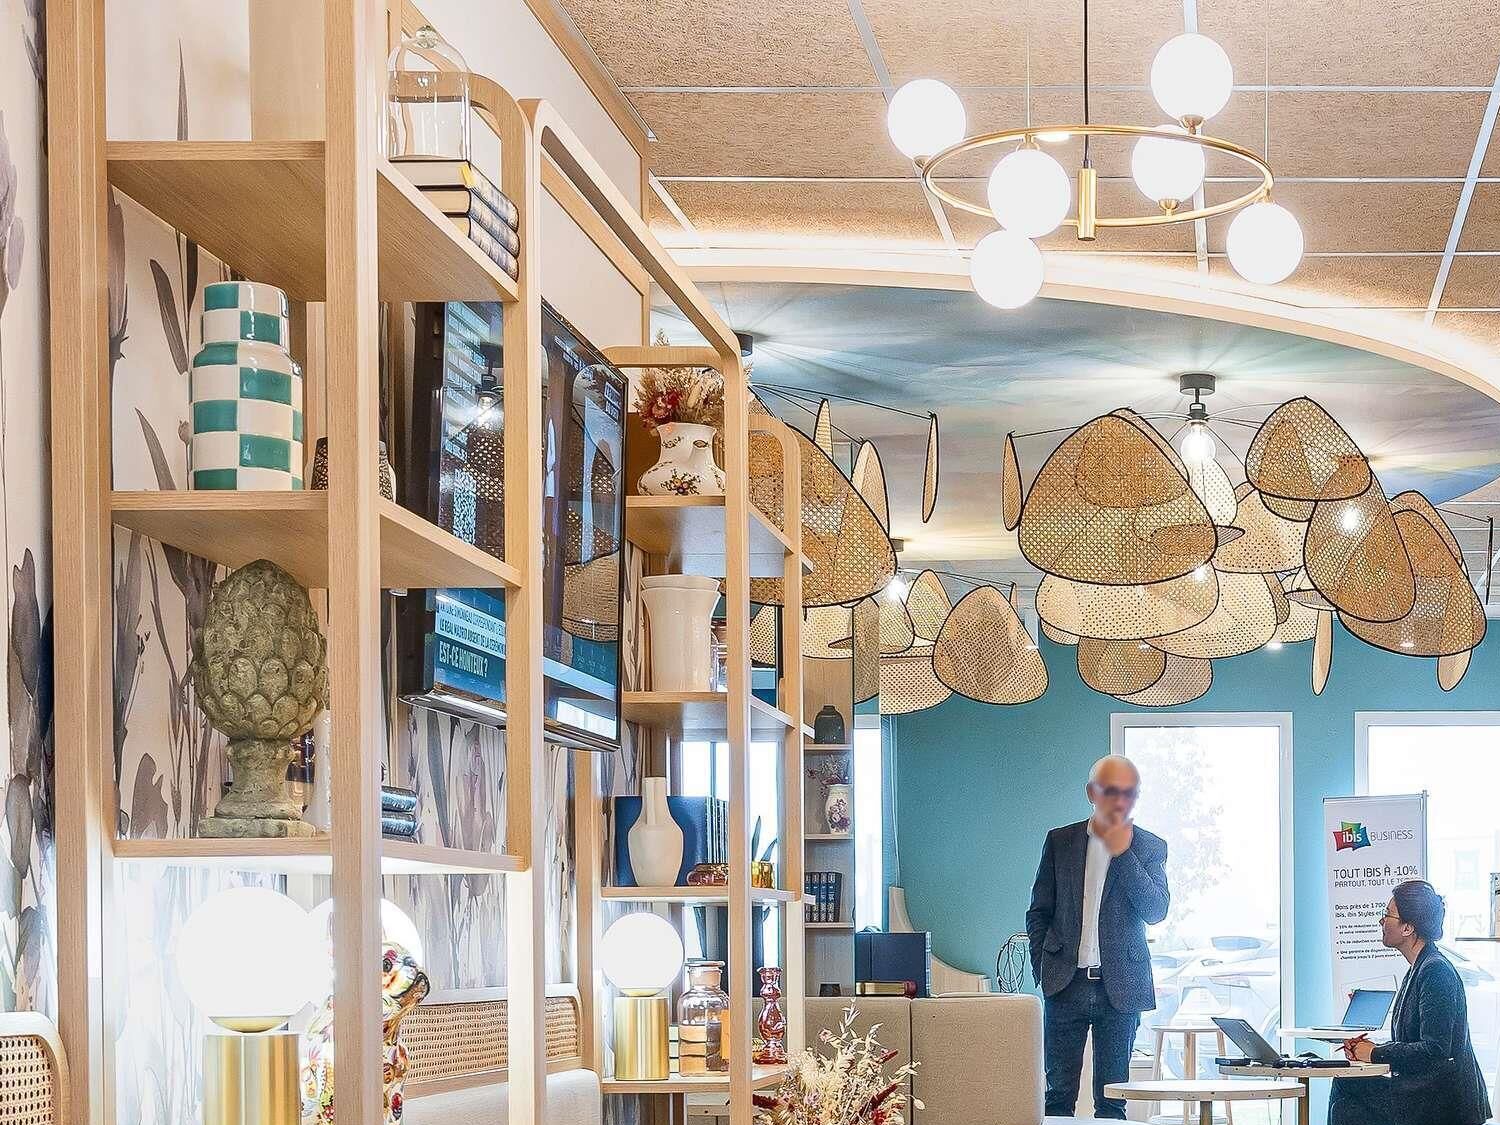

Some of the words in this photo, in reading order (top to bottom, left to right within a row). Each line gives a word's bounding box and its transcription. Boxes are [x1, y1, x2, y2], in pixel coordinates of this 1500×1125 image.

[1342, 831, 1362, 843] ibis
[1370, 829, 1414, 842] BUSINESS
[1333, 868, 1361, 879] TOUT
[1363, 867, 1382, 878] IBIS
[1384, 865, 1391, 876] À
[1394, 865, 1418, 876] -10%
[1368, 879, 1386, 887] TOUT
[1386, 878, 1395, 886] LE
